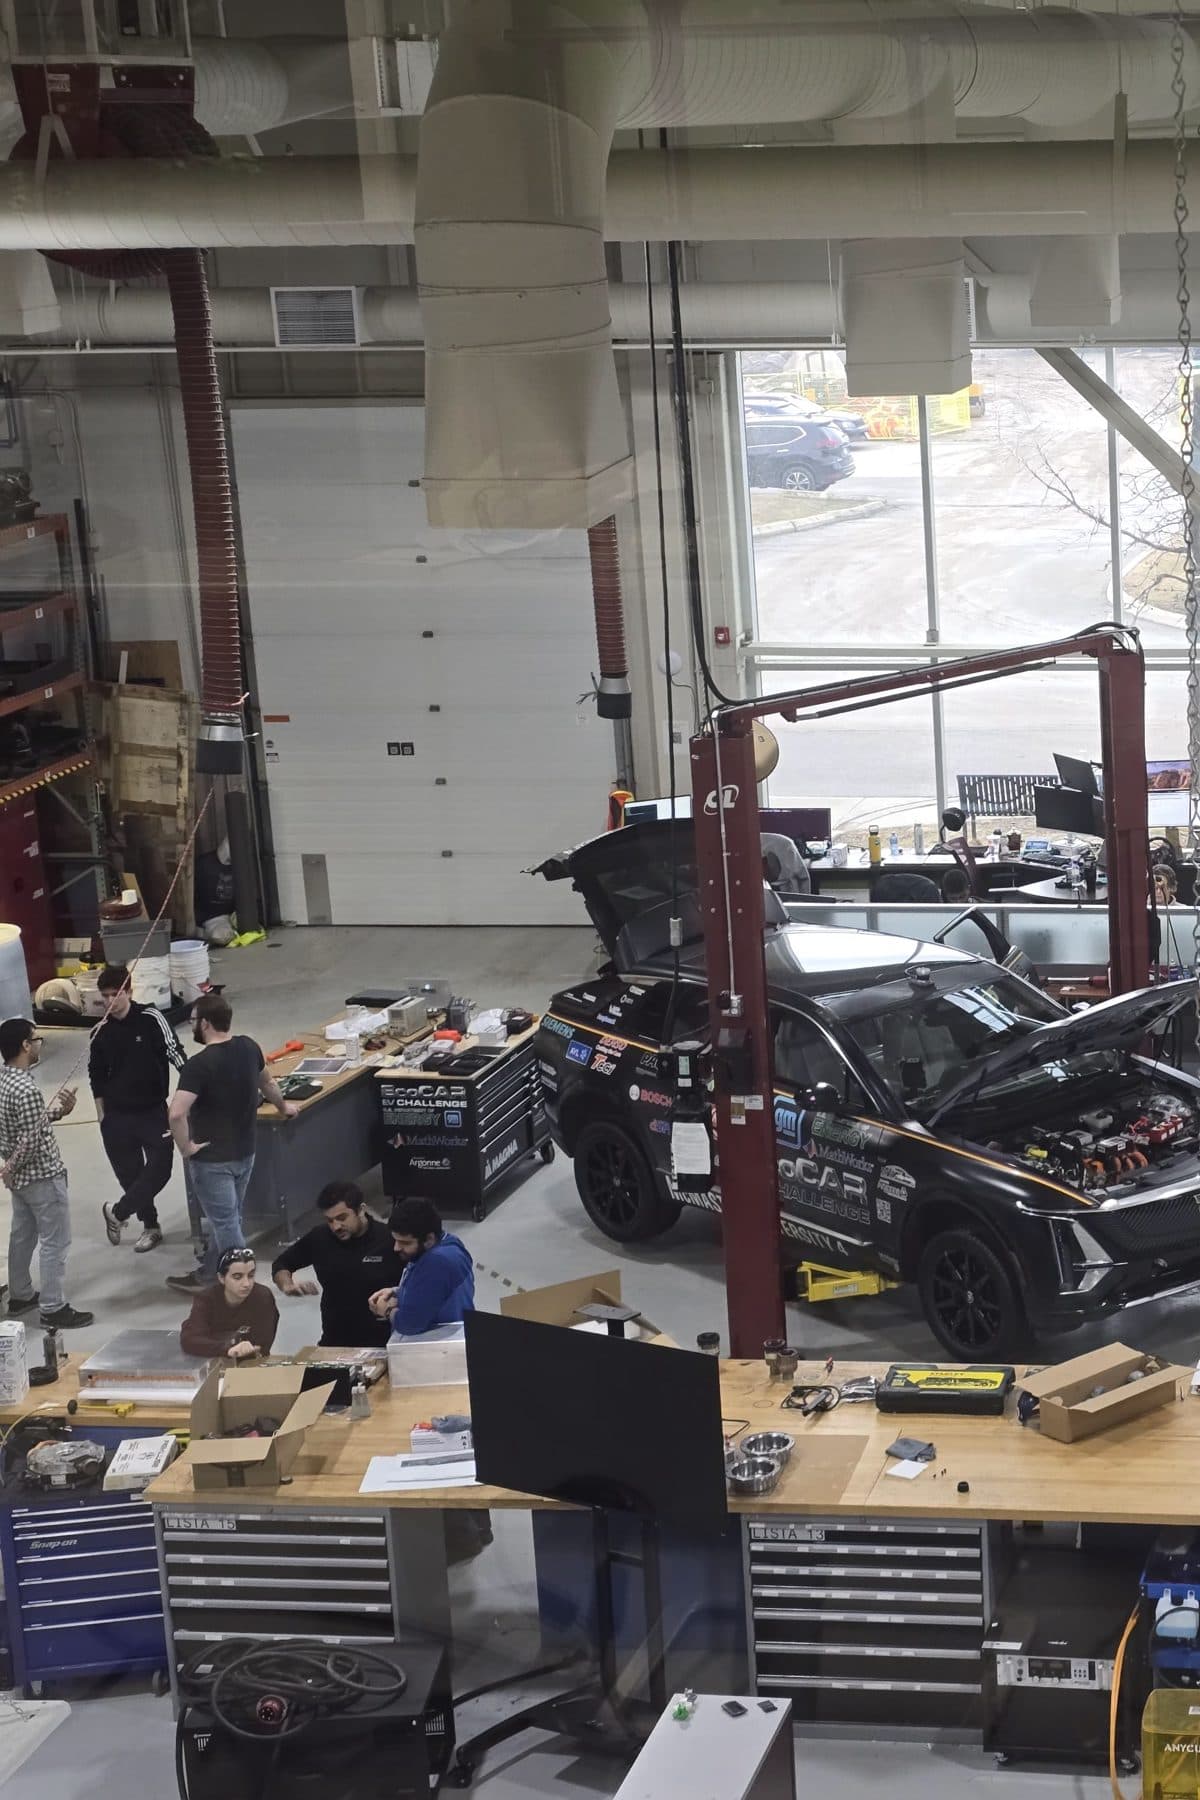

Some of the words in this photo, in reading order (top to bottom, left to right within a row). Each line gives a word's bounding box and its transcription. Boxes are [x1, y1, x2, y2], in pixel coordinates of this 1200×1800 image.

[541, 1015, 576, 1039] SIEMENS
[380, 1084, 466, 1099] EcoCAR
[640, 1088, 673, 1108] BOSCH
[396, 1099, 468, 1108] CHALLENGE
[774, 1106, 797, 1134] gm
[407, 1135, 467, 1147] MathWorks
[409, 1158, 441, 1169] Argonne
[491, 1138, 518, 1173] MAGNA
[816, 1143, 874, 1174] MathWorks
[778, 1157, 868, 1207] oCAR
[779, 1183, 871, 1225] HALLENGE
[166, 1518, 210, 1529] LISTA
[219, 1518, 235, 1529] 15
[753, 1527, 798, 1539] LISTA
[808, 1529, 824, 1540] 13
[29, 1538, 78, 1550] Snap-on
